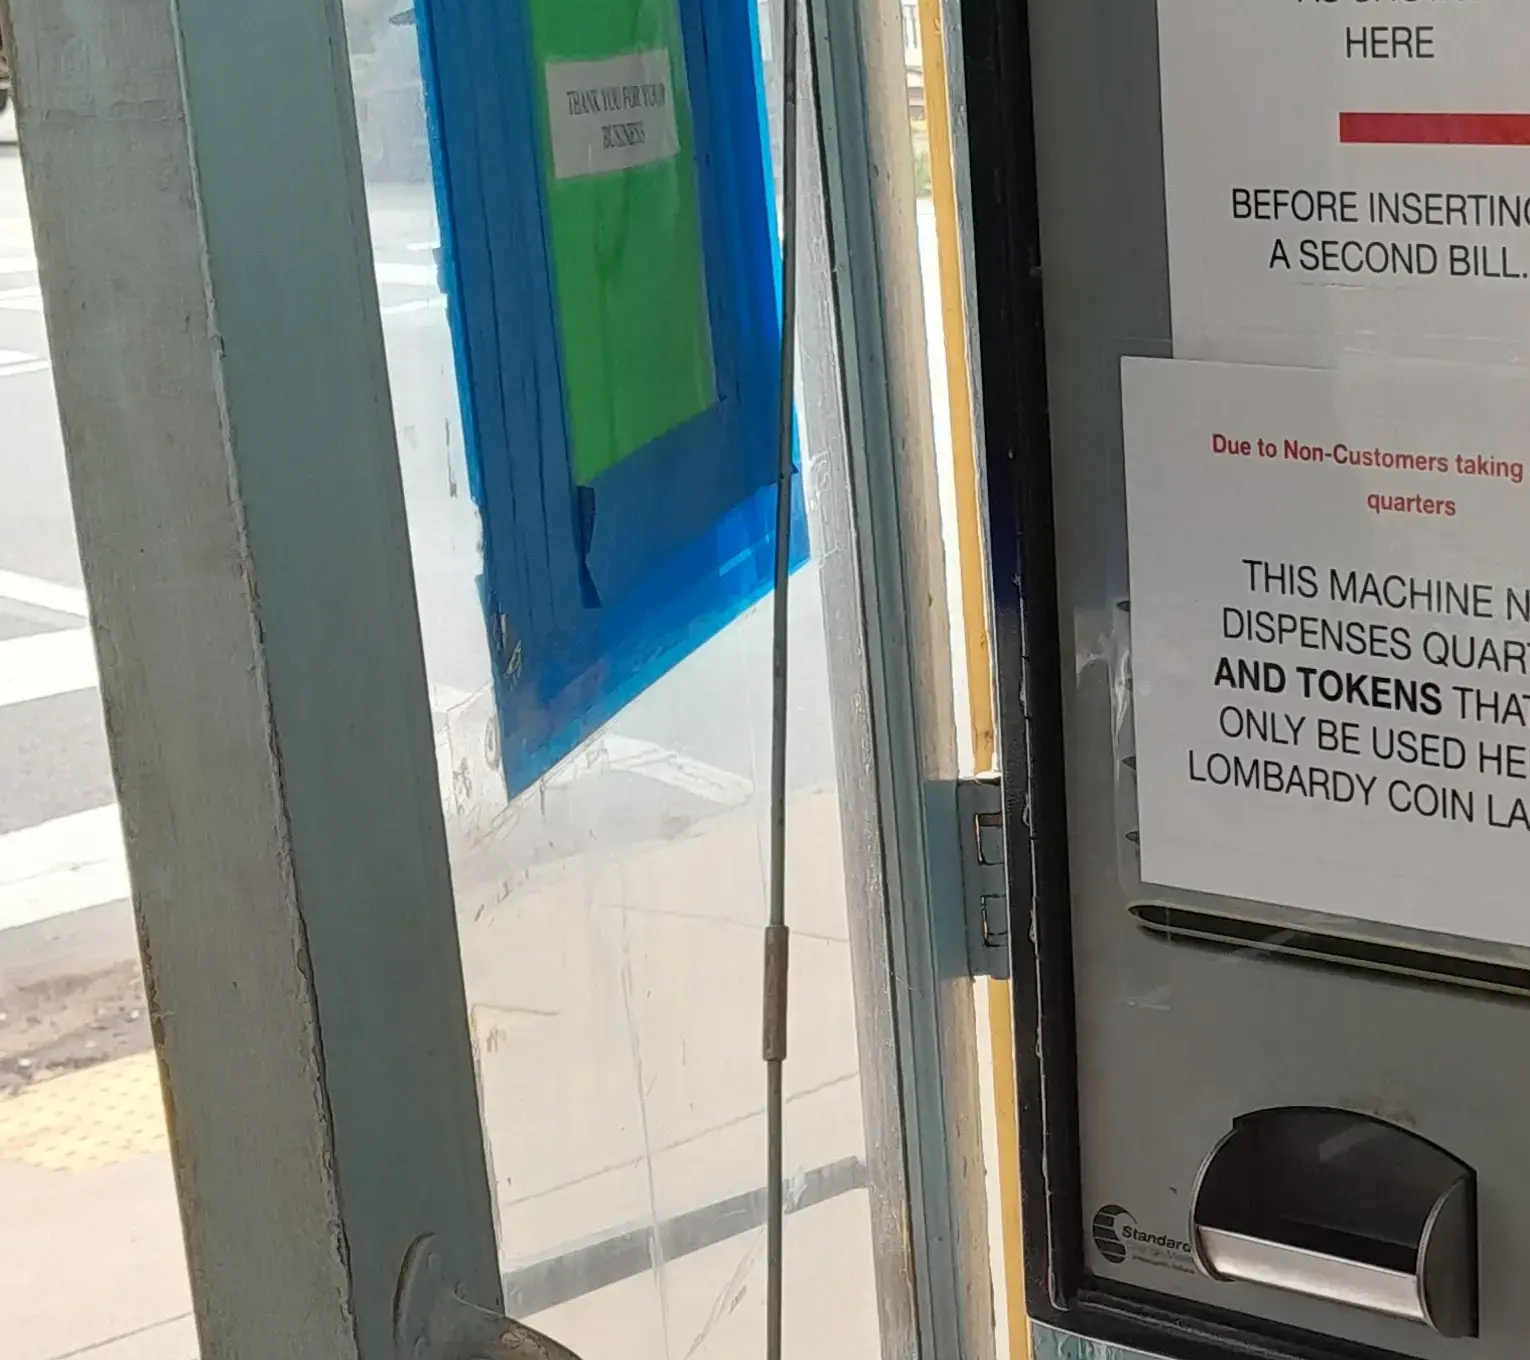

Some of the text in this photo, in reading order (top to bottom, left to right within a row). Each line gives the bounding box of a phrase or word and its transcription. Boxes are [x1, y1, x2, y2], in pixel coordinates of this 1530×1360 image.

[1347, 27, 1434, 58] HERE
[1233, 189, 1357, 222] BEFORE
[1270, 239, 1527, 278] A SECOND BILL.
[1213, 434, 1251, 455] Due
[1257, 439, 1277, 458] to
[1284, 440, 1448, 472] Non-Customers
[1456, 455, 1523, 483] taking
[1368, 494, 1455, 516] quarters
[1242, 559, 1317, 598] THIS
[1331, 569, 1492, 617] MACHINE
[1224, 608, 1411, 660] DISPENSES
[1215, 657, 1285, 693] AND
[1296, 667, 1442, 715] TOKENS
[1220, 706, 1306, 745] ONLY
[1318, 719, 1360, 754] BE
[1373, 727, 1465, 769] USED
[1190, 747, 1381, 805] LOMBARDY
[1389, 780, 1473, 822] COIN
